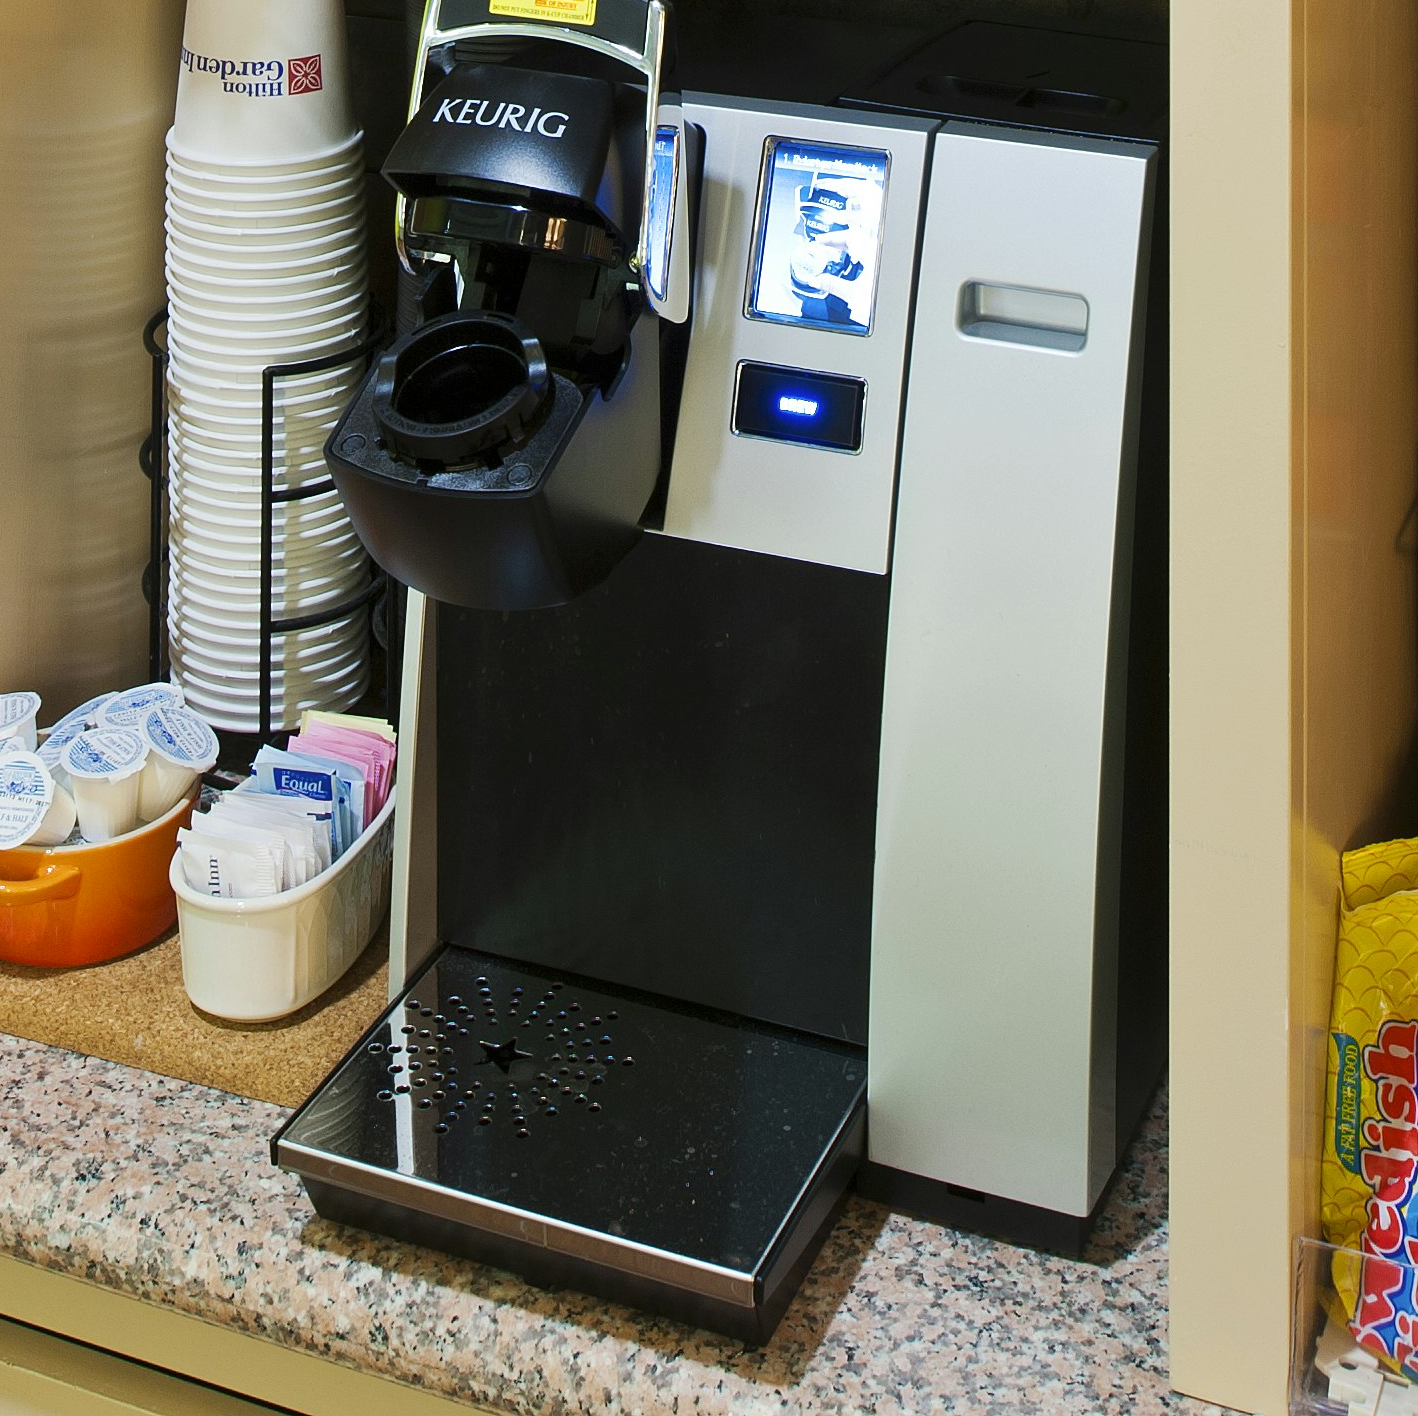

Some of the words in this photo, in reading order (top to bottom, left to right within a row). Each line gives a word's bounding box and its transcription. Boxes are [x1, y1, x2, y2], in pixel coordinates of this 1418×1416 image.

[198, 56, 283, 82] Garden
[223, 81, 283, 97] Hilton
[432, 98, 570, 138] KEURIG
[281, 775, 325, 793] Equal
[13, 815, 28, 823] HALF
[1344, 1044, 1359, 1083] FOOD
[1341, 1085, 1356, 1126] FREE
